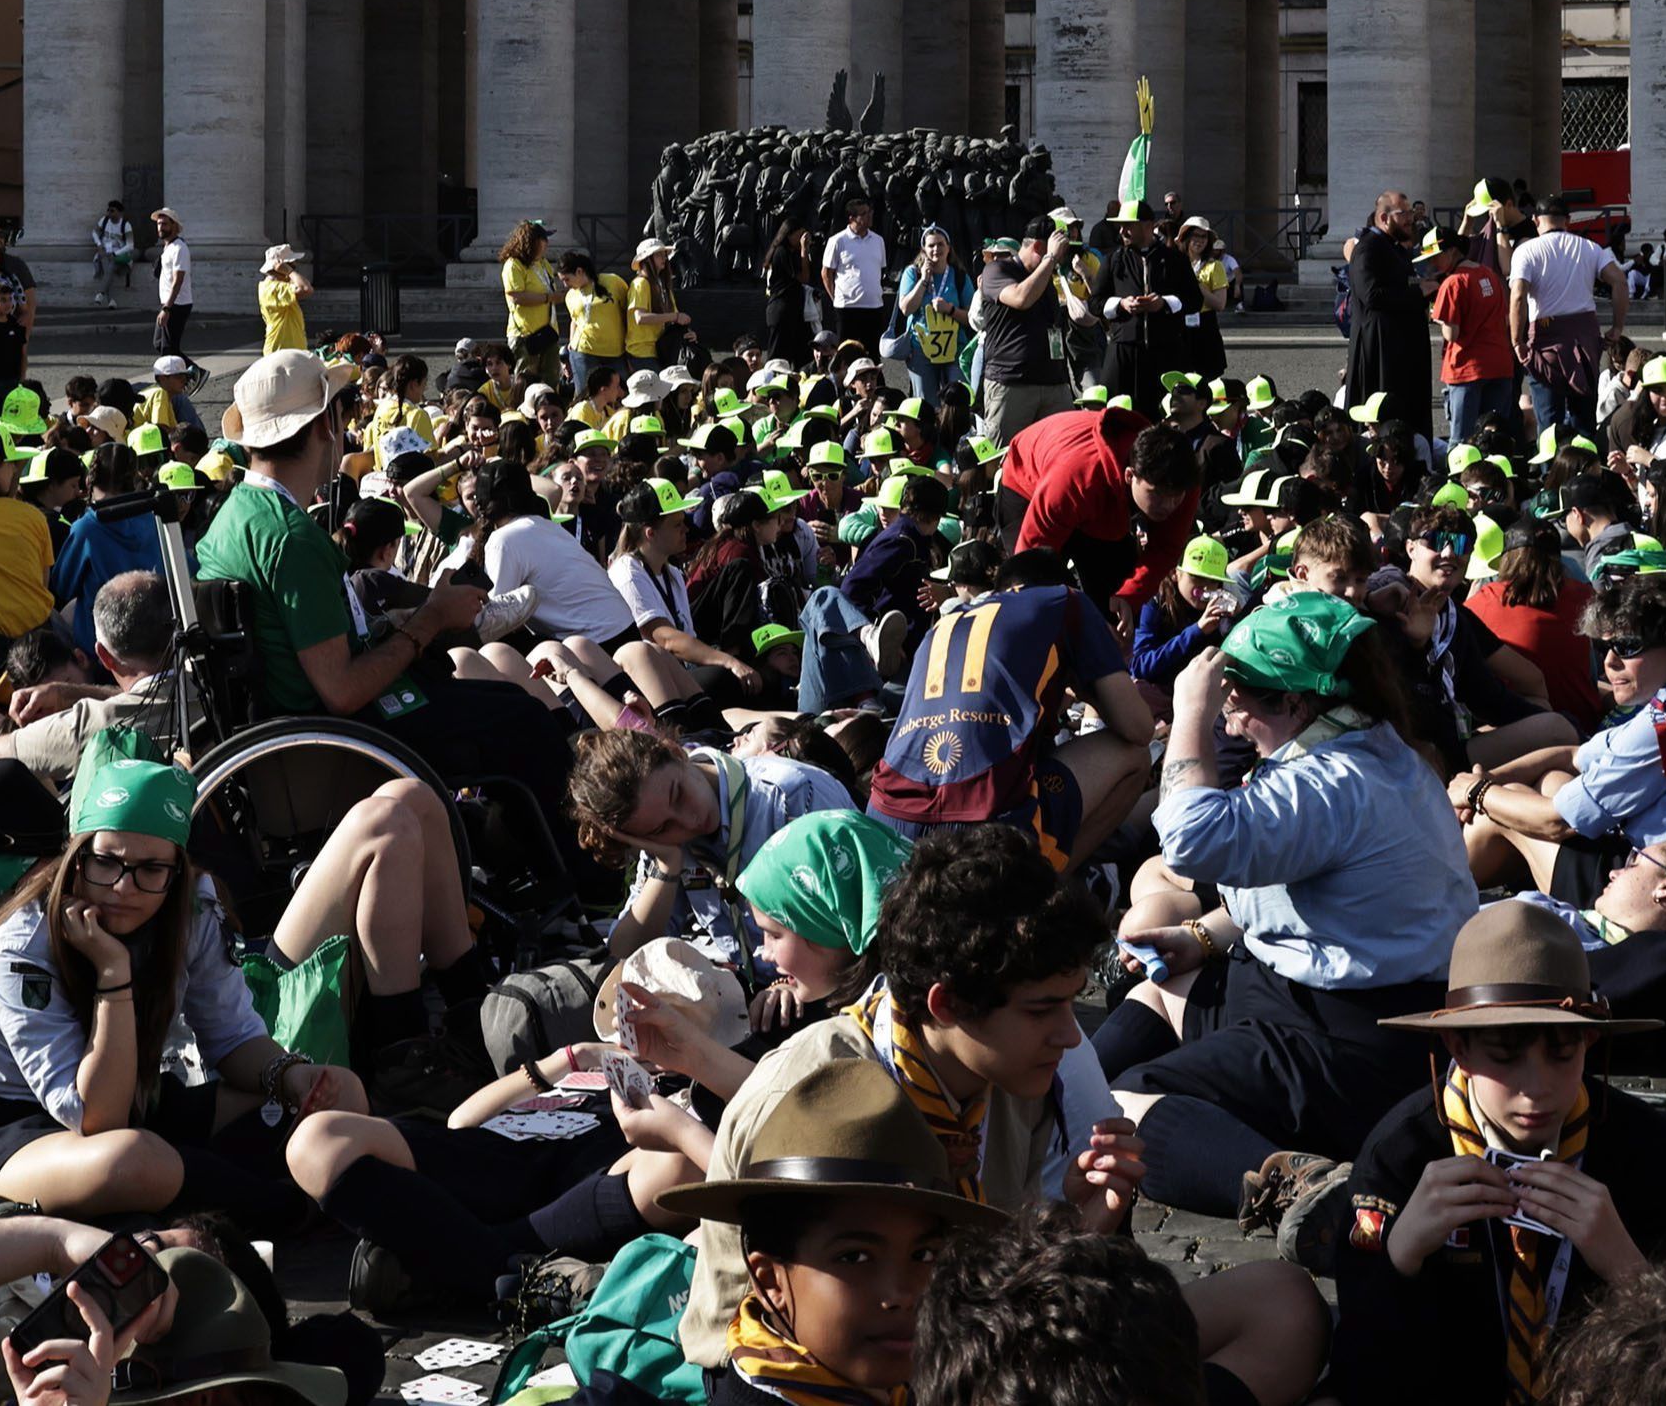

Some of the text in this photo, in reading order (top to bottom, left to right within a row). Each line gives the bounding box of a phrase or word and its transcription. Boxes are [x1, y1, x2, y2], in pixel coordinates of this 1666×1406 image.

[930, 330, 954, 358] 37
[924, 602, 1002, 702] 11
[949, 707, 1012, 727] Resorts
